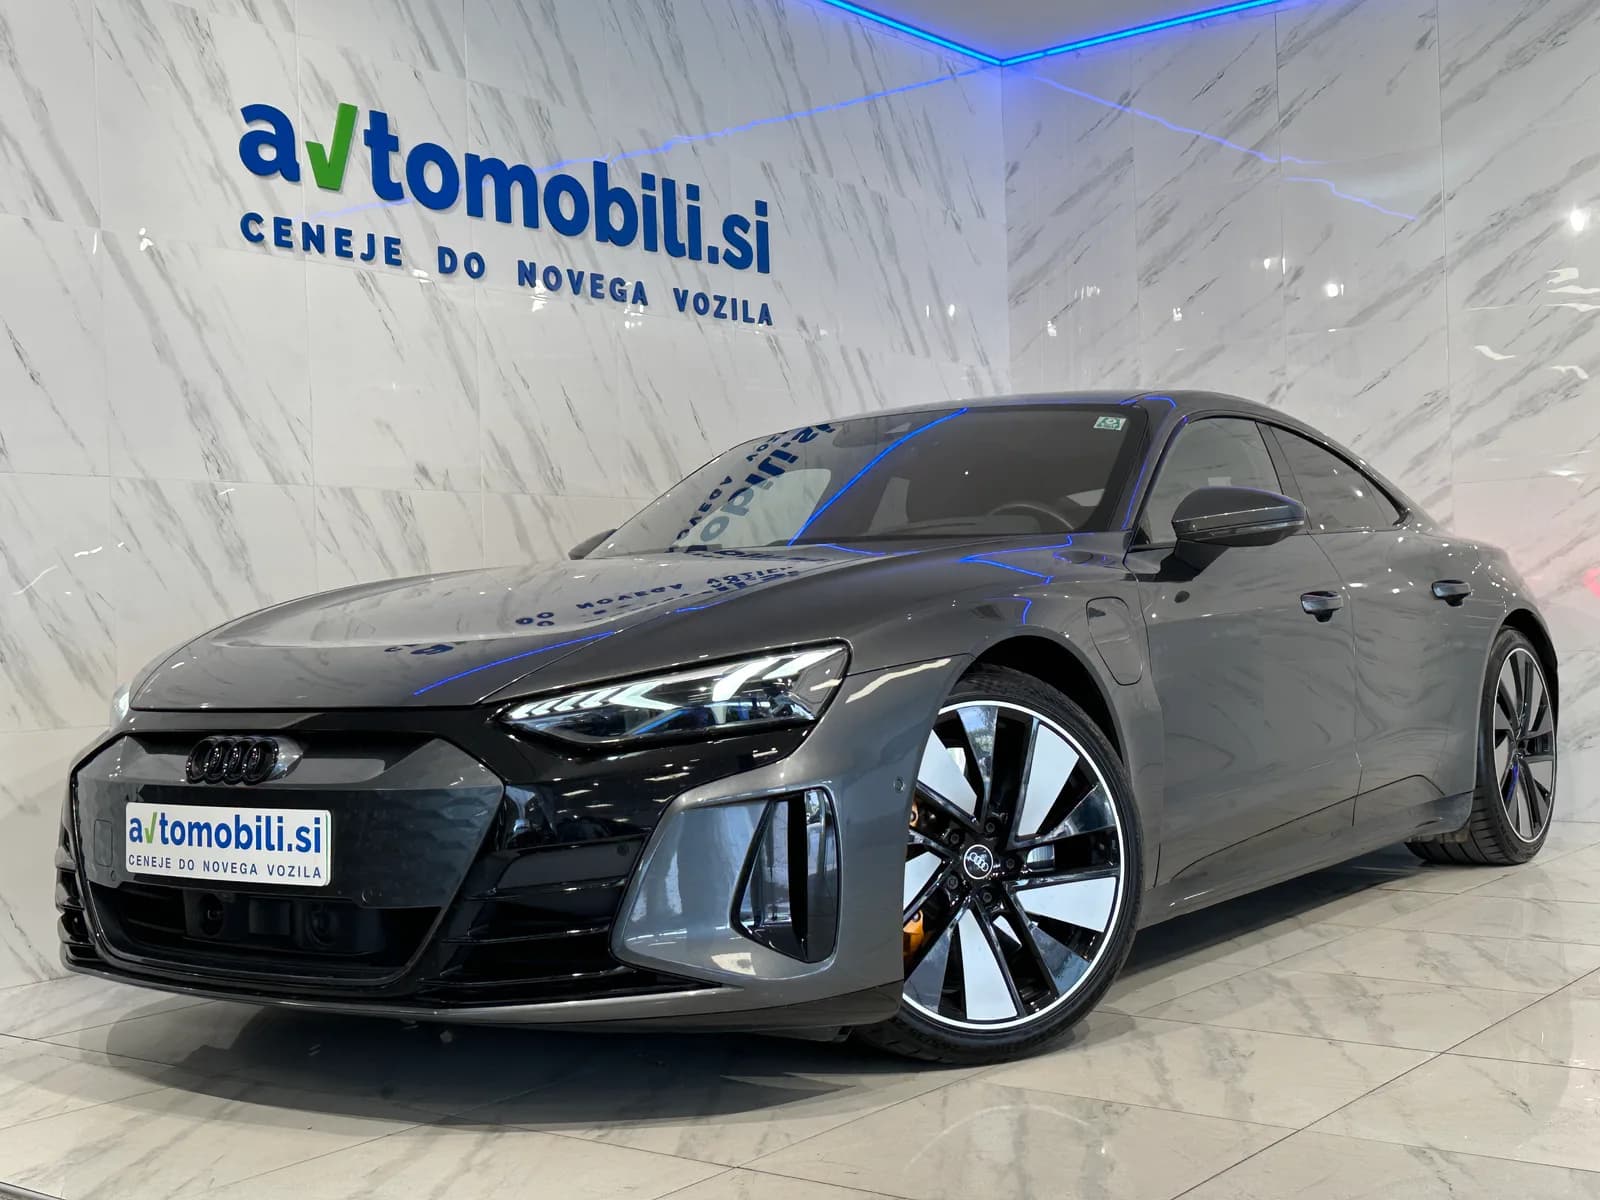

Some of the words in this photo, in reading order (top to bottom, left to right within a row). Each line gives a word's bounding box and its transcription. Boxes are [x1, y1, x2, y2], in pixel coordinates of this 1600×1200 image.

[239, 211, 403, 267] CENEJE
[437, 246, 486, 280] DO
[517, 259, 649, 306] NOVEGA
[673, 287, 773, 326] VOZILA
[128, 854, 172, 869] CENEJE
[178, 858, 195, 871] DO
[203, 860, 258, 875] NOVEGA
[267, 864, 322, 879] VOZILA
